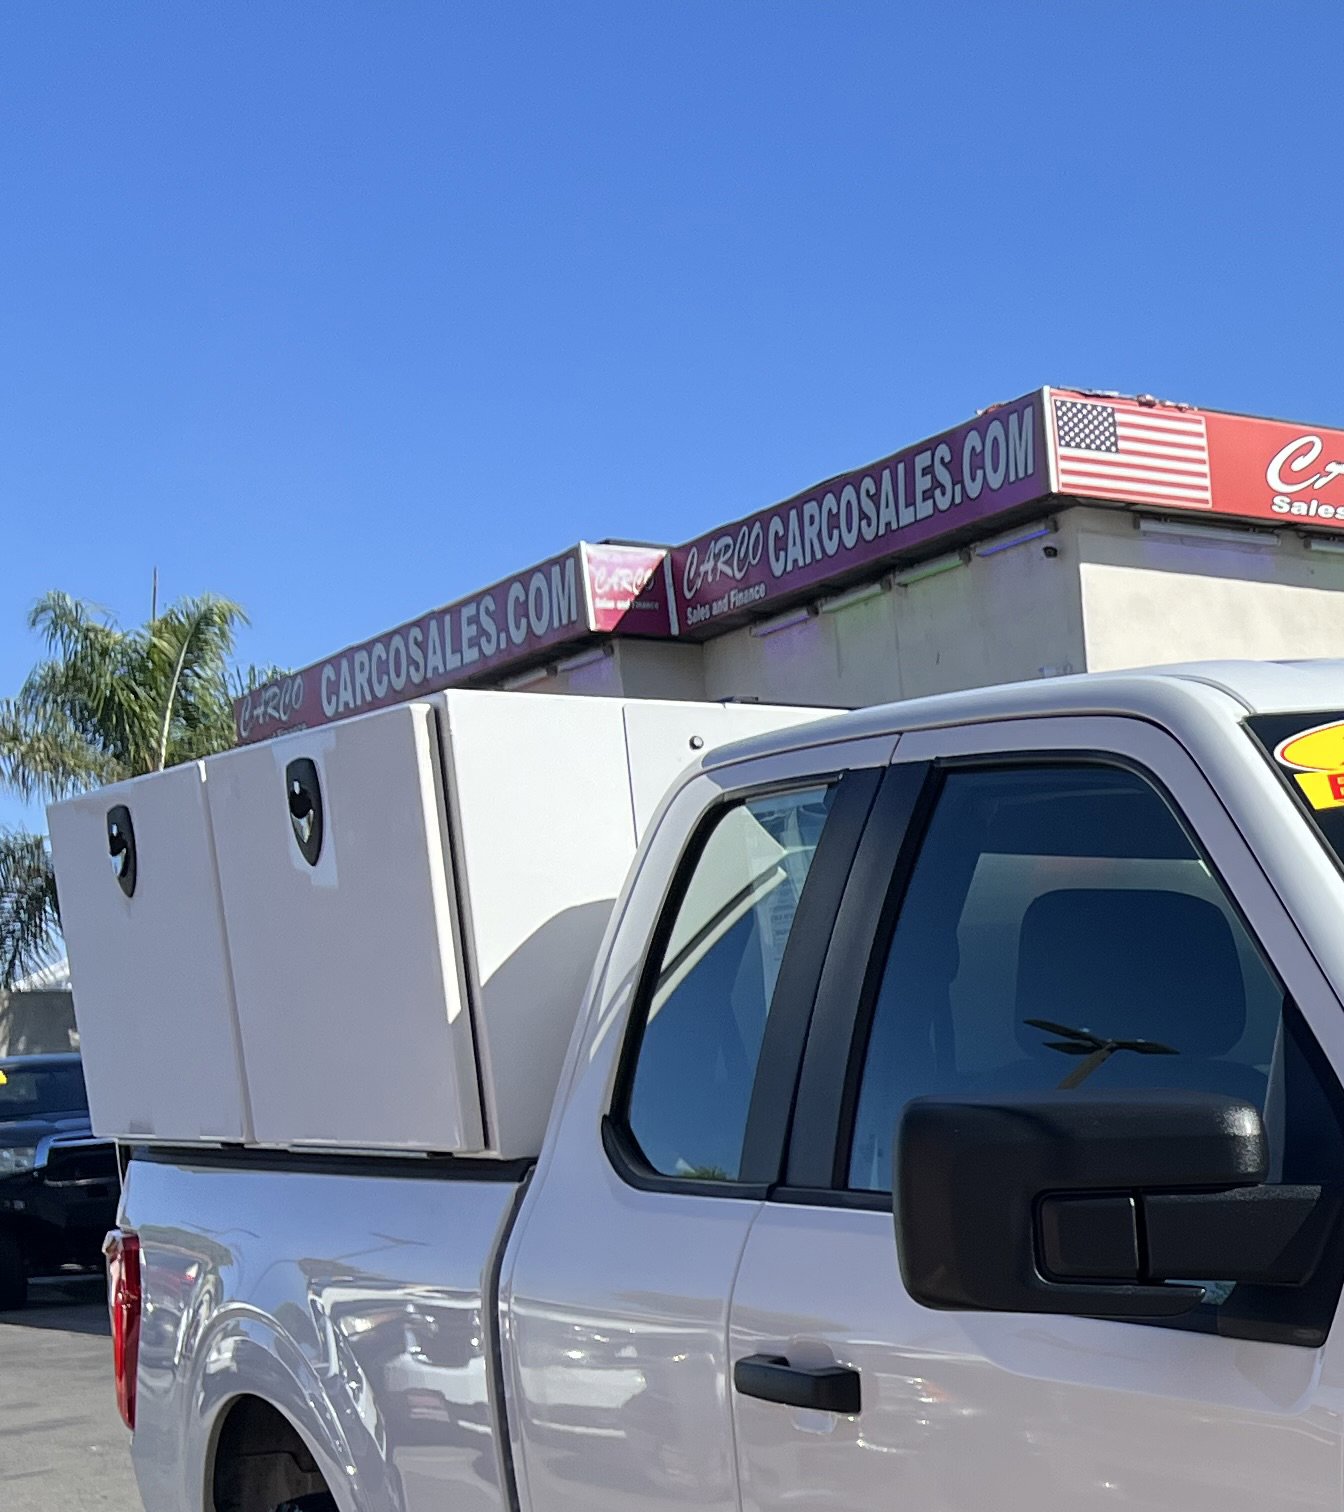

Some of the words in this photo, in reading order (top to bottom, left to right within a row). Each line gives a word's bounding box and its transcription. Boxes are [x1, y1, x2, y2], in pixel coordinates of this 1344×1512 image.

[683, 520, 763, 600] CARCO
[767, 405, 1034, 578] CARCOSALES.COM
[593, 566, 655, 594] CARCO
[686, 602, 711, 626] Sales
[712, 597, 729, 617] and
[730, 581, 766, 610] Finance
[240, 675, 304, 738] CARCO
[321, 557, 577, 718] CARCOSALES.COM
